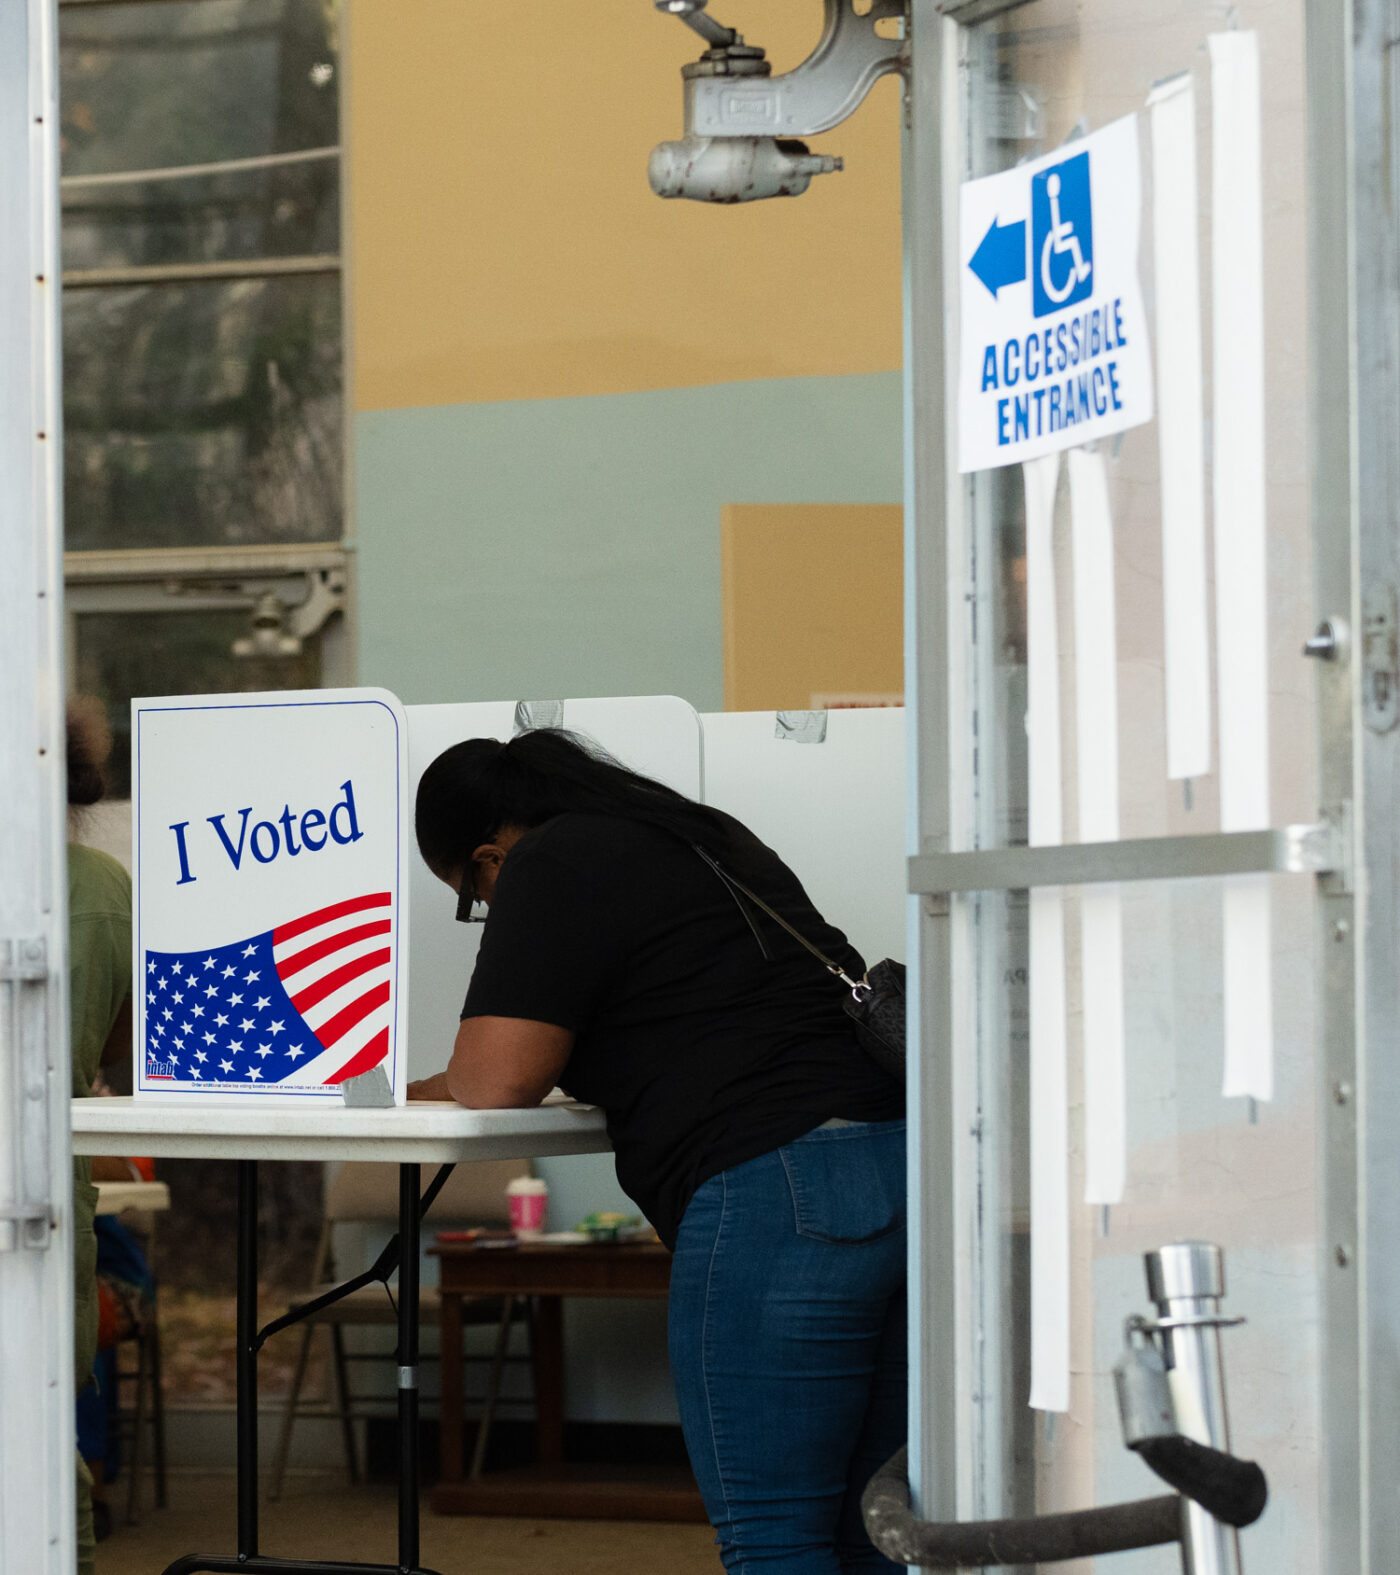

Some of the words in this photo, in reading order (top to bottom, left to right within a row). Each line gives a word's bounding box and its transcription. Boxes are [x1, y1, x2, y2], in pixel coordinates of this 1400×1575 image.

[981, 298, 1127, 393] ACCESSIBLE
[997, 361, 1123, 447] ENTRANCE
[169, 821, 197, 885] I
[206, 779, 364, 871] Voted
[147, 1060, 175, 1077] intab
